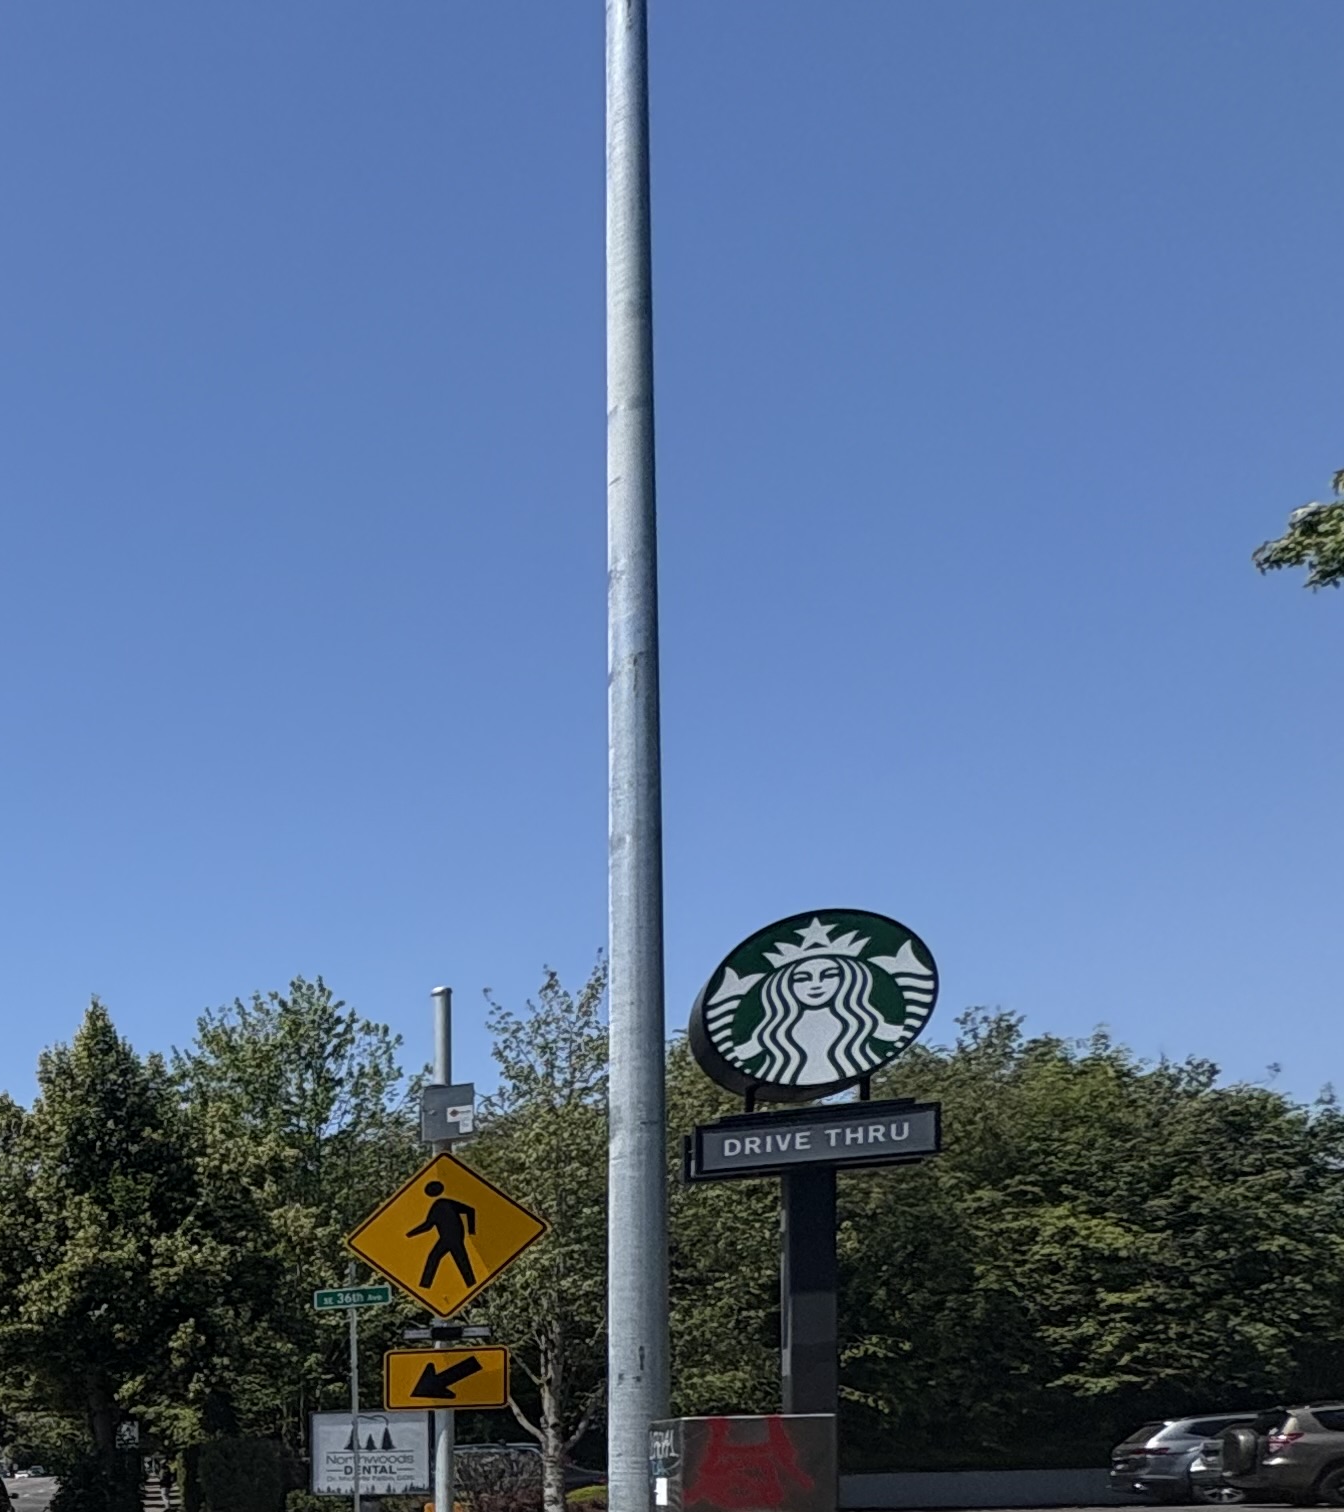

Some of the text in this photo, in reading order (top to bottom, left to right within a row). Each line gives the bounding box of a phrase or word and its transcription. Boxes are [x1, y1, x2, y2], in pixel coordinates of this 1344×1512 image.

[723, 1122, 910, 1156] DRIVE THRU
[337, 1292, 364, 1304] 36th
[326, 1455, 414, 1465] Norhwoods
[344, 1465, 397, 1475] DENTAL
